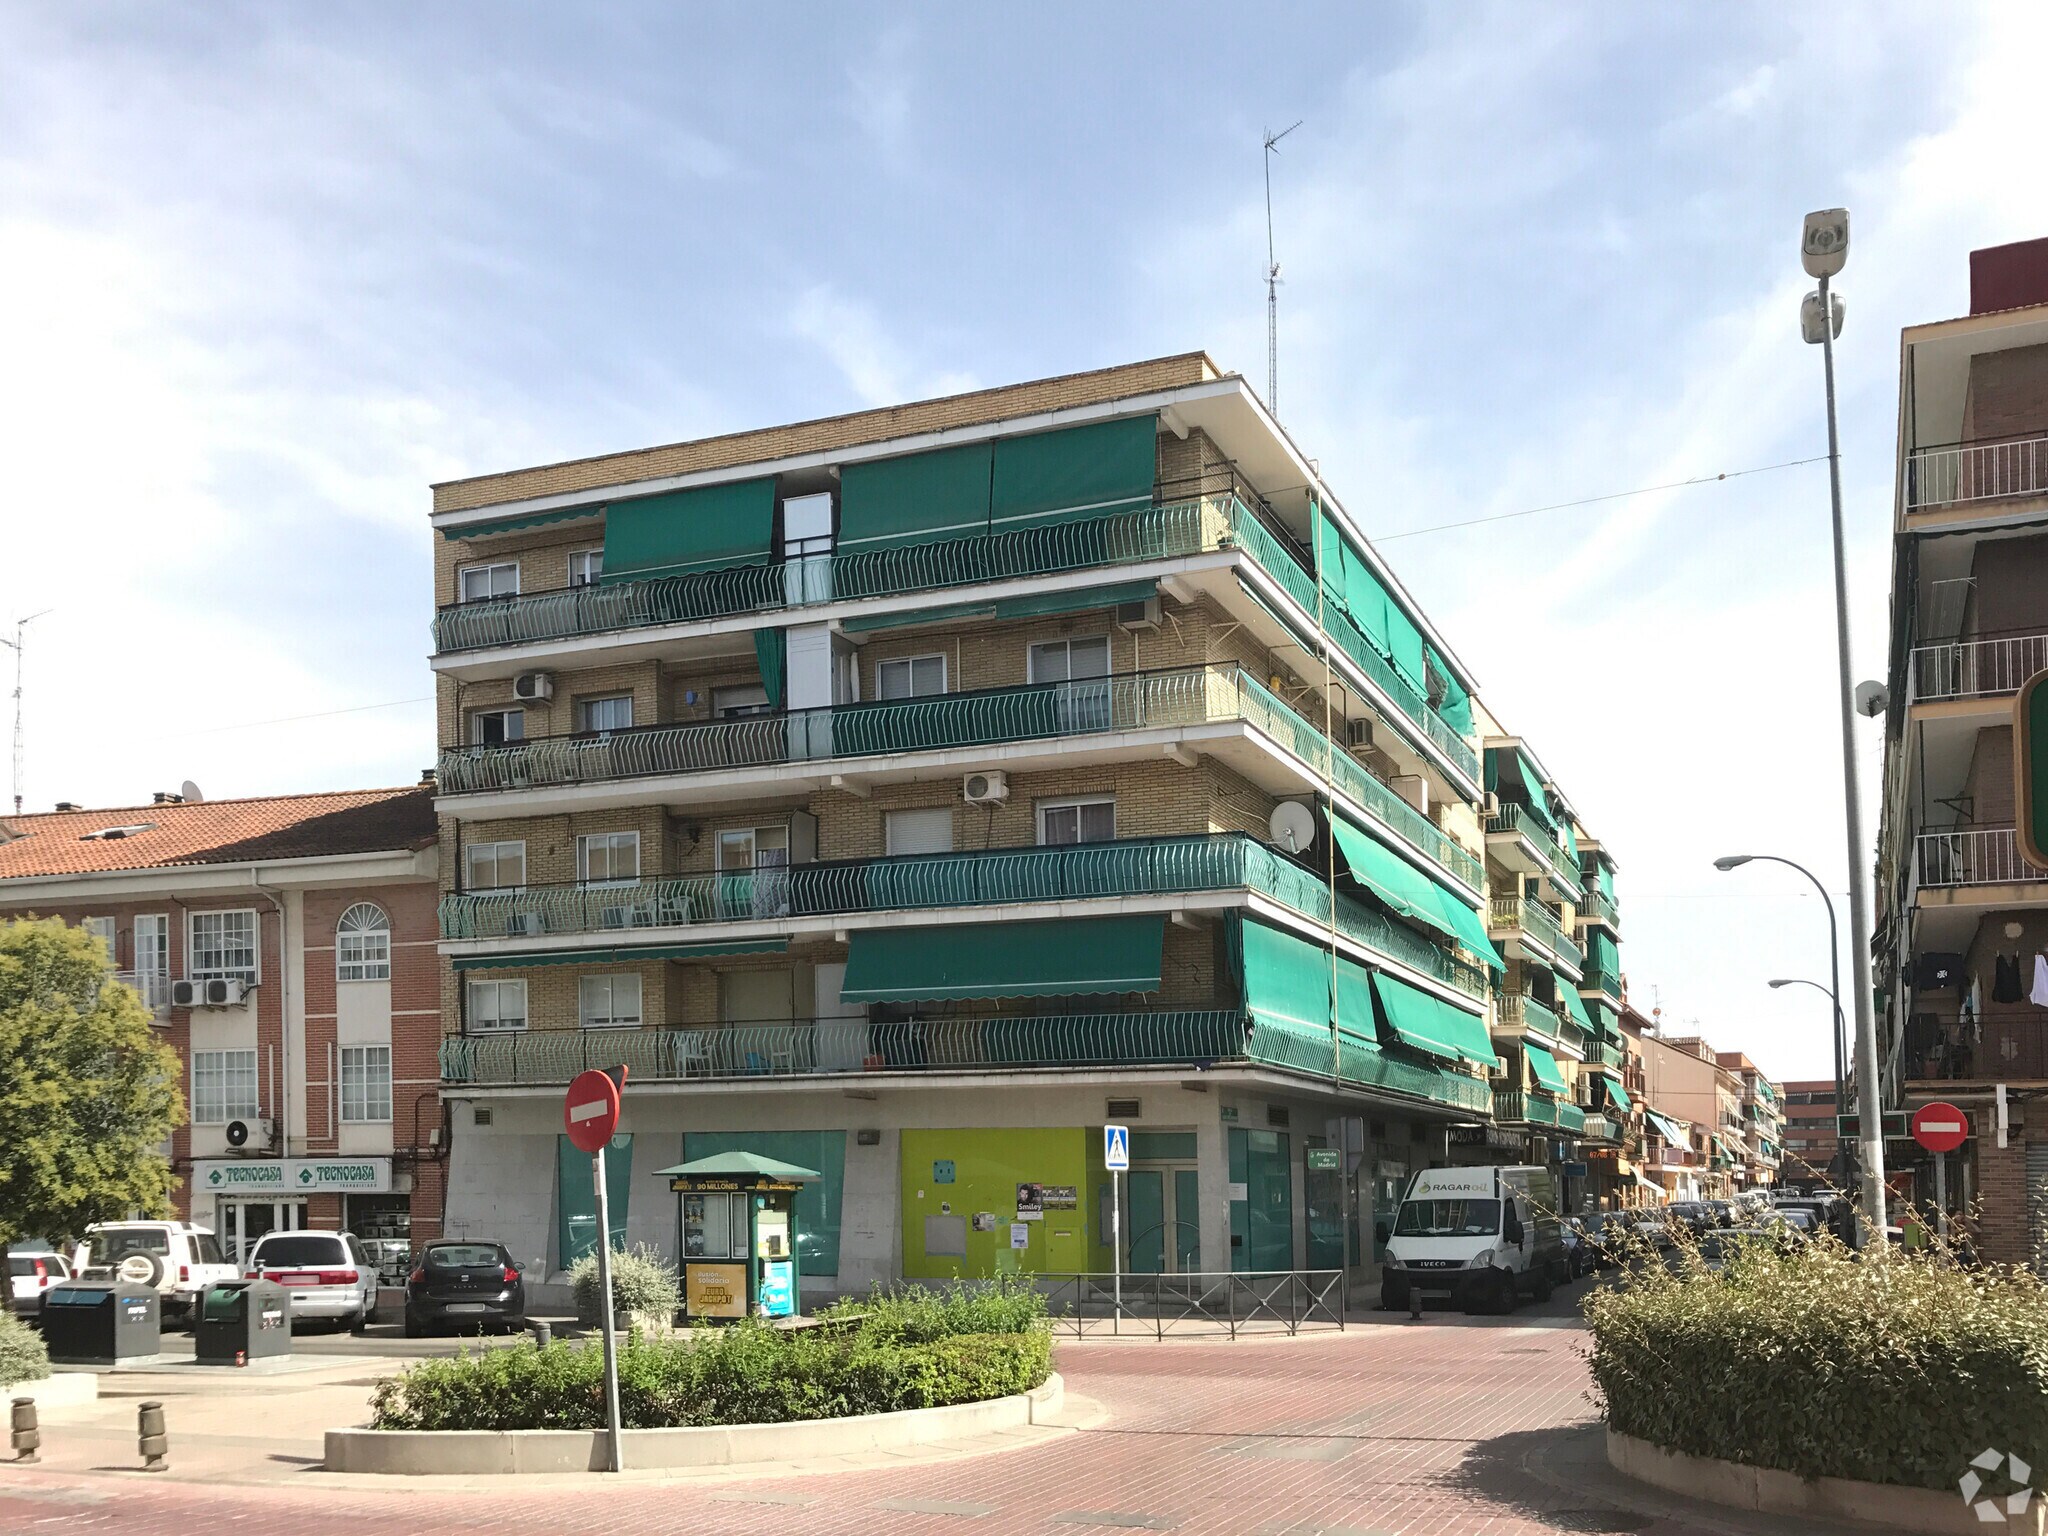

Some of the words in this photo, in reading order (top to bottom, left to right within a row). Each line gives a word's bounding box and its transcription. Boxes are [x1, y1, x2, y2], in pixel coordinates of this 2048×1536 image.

[1450, 1129, 1474, 1142] MODA
[225, 1166, 282, 1182] TECNOCASA
[317, 1165, 375, 1181] TECNOCASA
[1018, 1203, 1042, 1211] Smiley
[700, 1295, 732, 1303] JACKPOT
